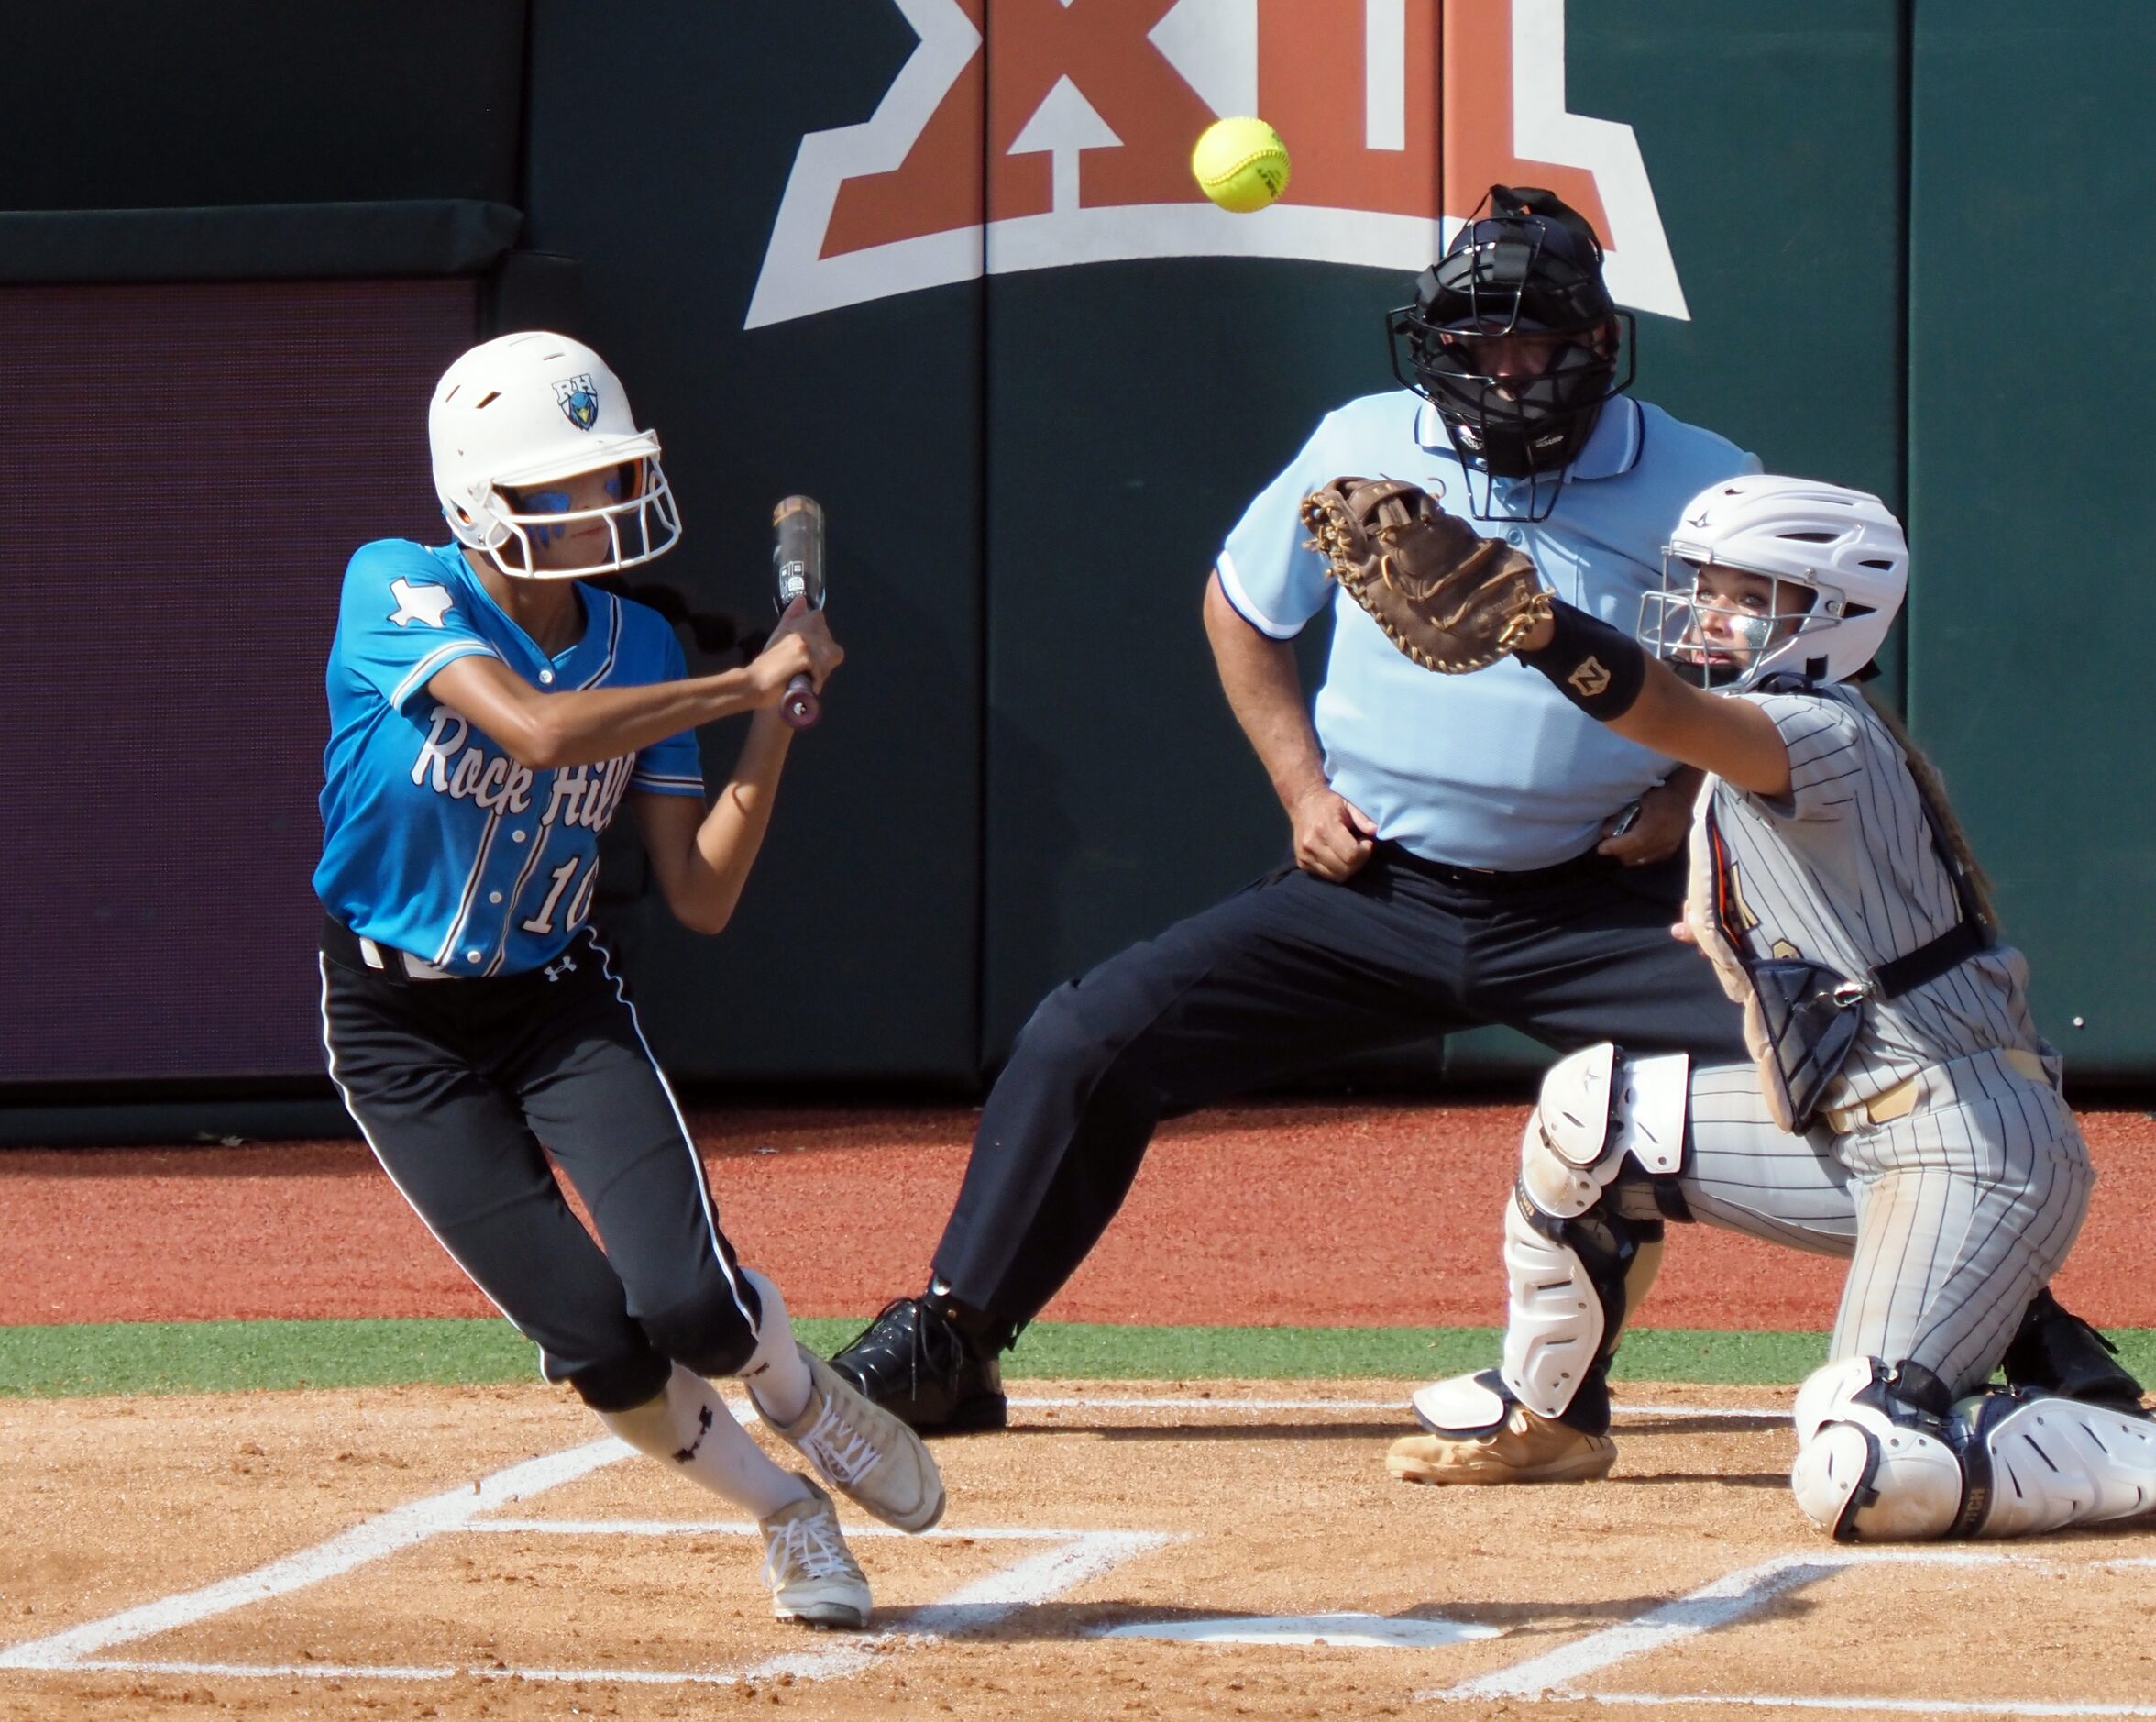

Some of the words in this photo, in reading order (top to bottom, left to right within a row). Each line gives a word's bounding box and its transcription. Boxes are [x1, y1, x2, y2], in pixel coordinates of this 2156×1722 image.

[551, 373, 598, 406] RH
[411, 704, 534, 816] Rock
[541, 750, 637, 833] Hill
